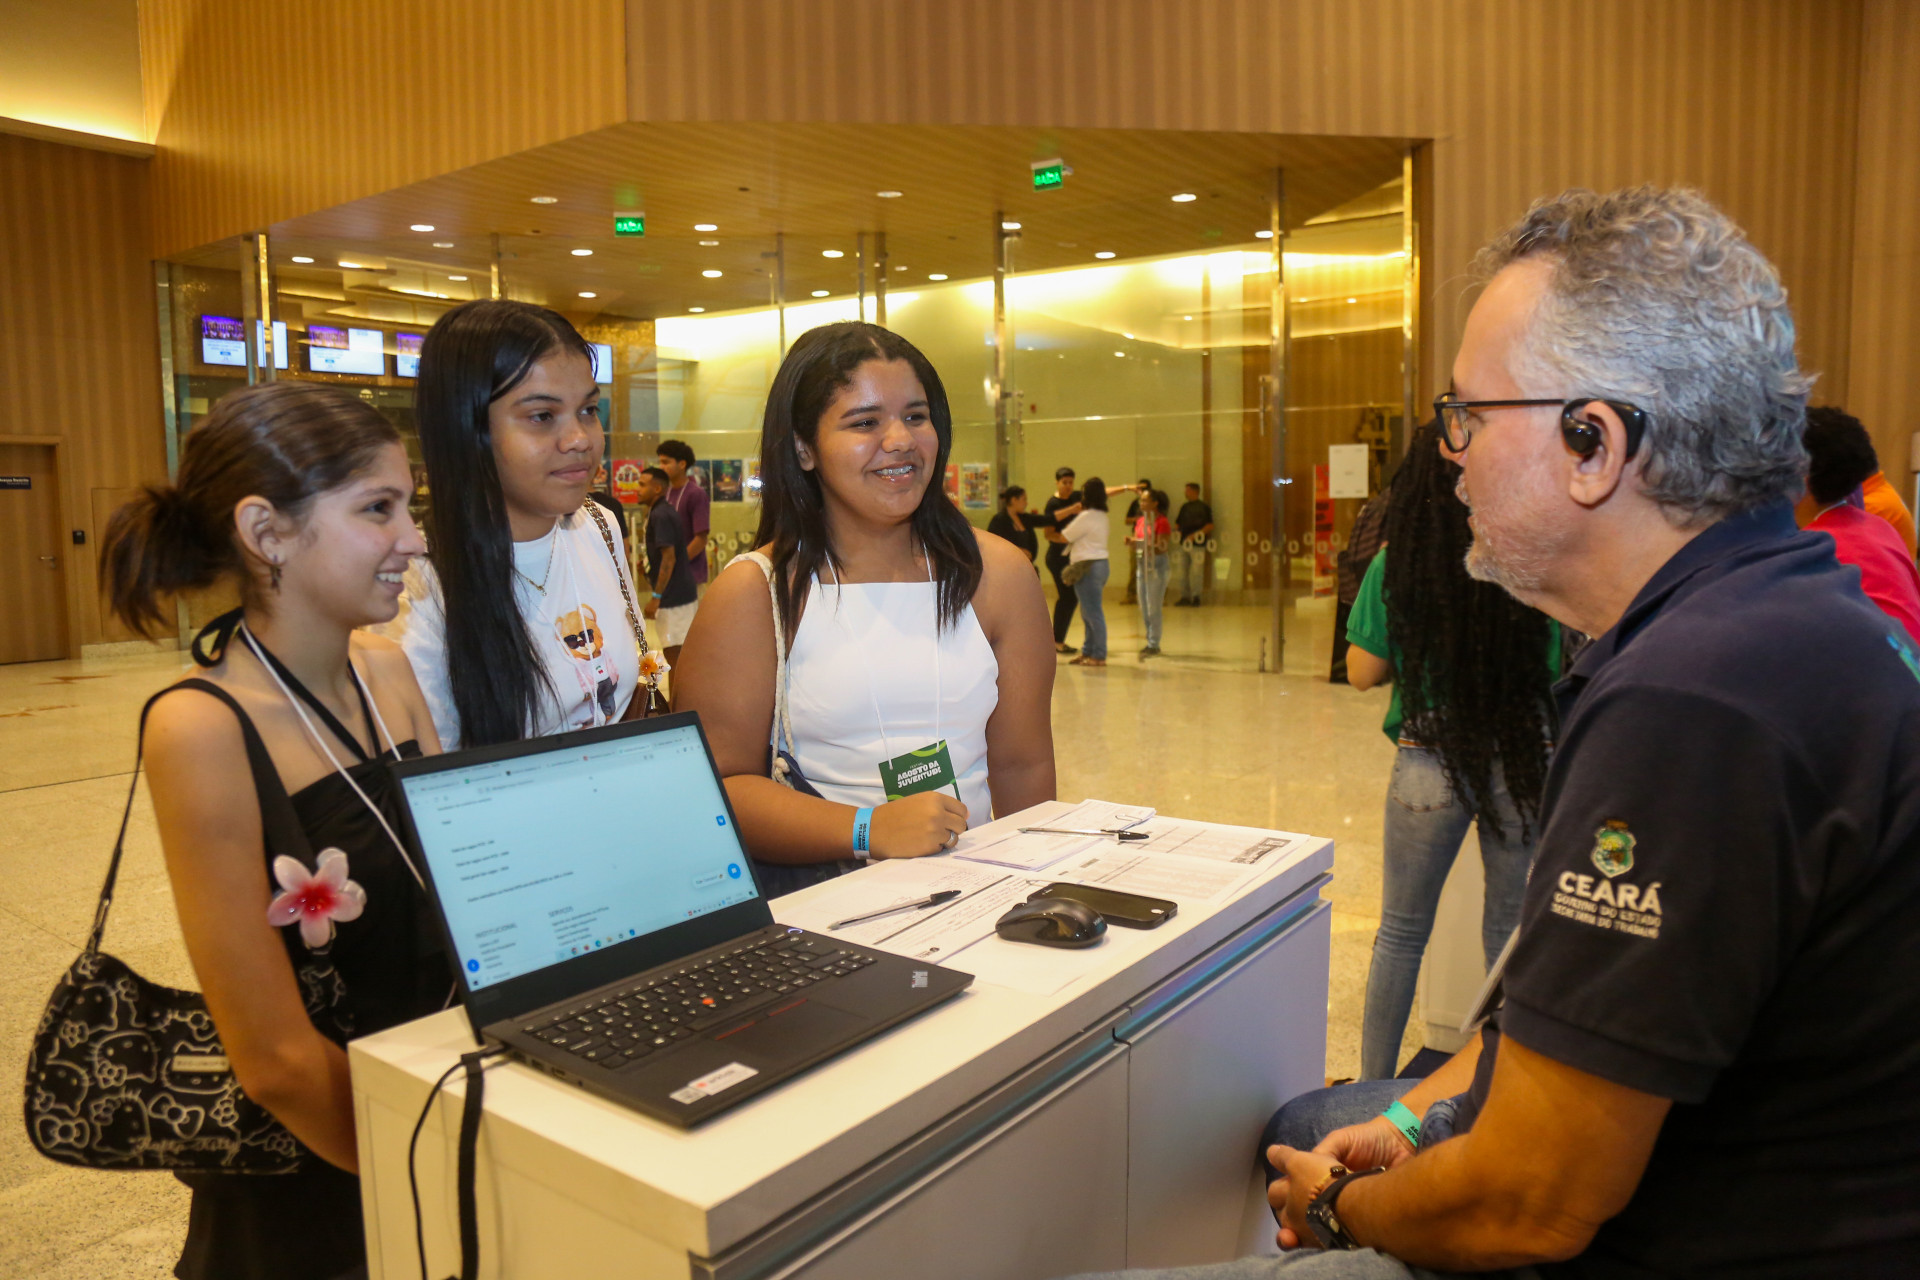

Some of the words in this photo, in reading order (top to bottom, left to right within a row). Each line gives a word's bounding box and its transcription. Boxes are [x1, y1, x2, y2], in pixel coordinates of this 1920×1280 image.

[897, 764, 928, 781] AGOSTO
[928, 760, 939, 769] DA
[1558, 871, 1663, 915] CEARÁ
